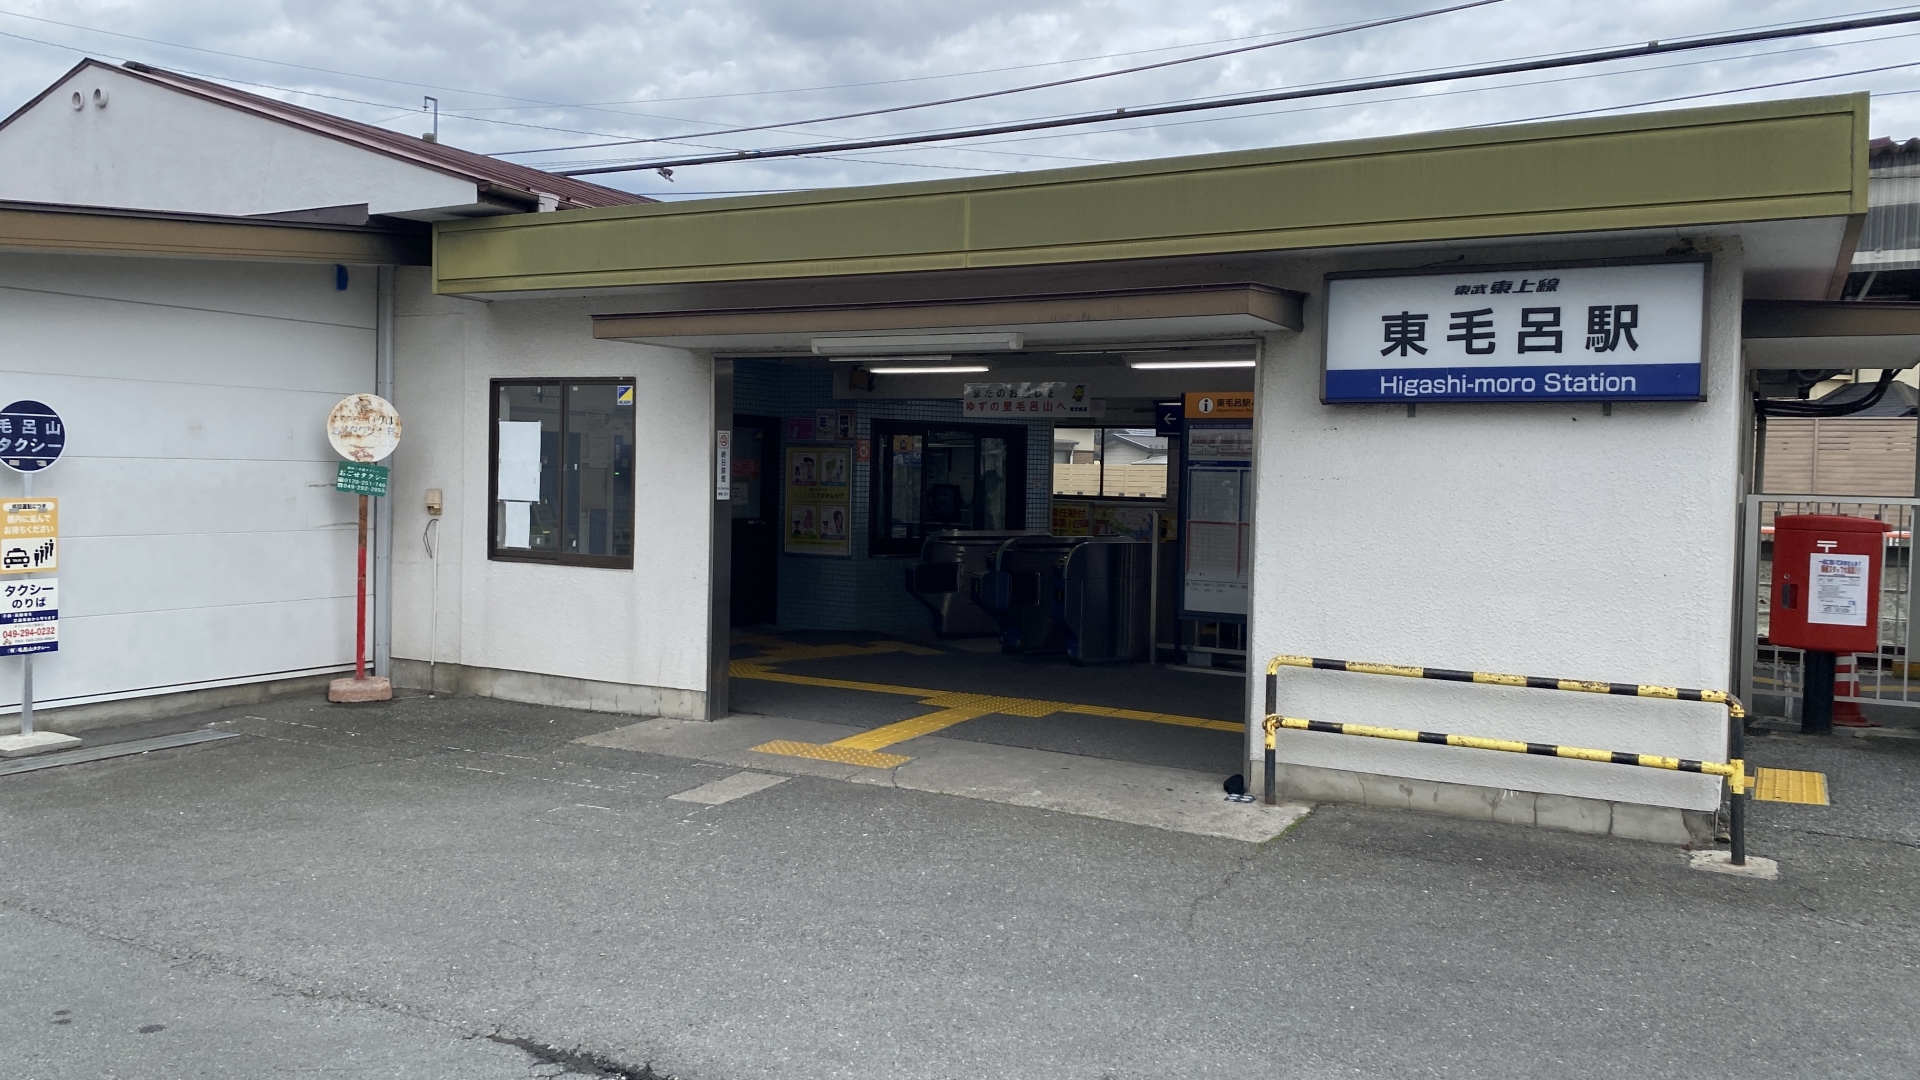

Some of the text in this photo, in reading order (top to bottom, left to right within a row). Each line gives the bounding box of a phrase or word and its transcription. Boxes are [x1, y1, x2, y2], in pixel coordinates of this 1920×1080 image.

[1454, 277, 1561, 296] 東武東上線
[1380, 304, 1639, 357] 東毛呂駅
[1380, 372, 1637, 397] Higashi-moro Station
[965, 401, 1068, 413] ゆずの里毛呂山へ
[0, 437, 62, 453] タクシー
[339, 469, 388, 482] おごせタクシー
[343, 483, 386, 493] 049-292-2055
[4, 525, 55, 535] お待ちください
[4, 583, 54, 597] タクシー
[12, 596, 46, 608] のりば
[2, 626, 55, 638] 049-294-0232
